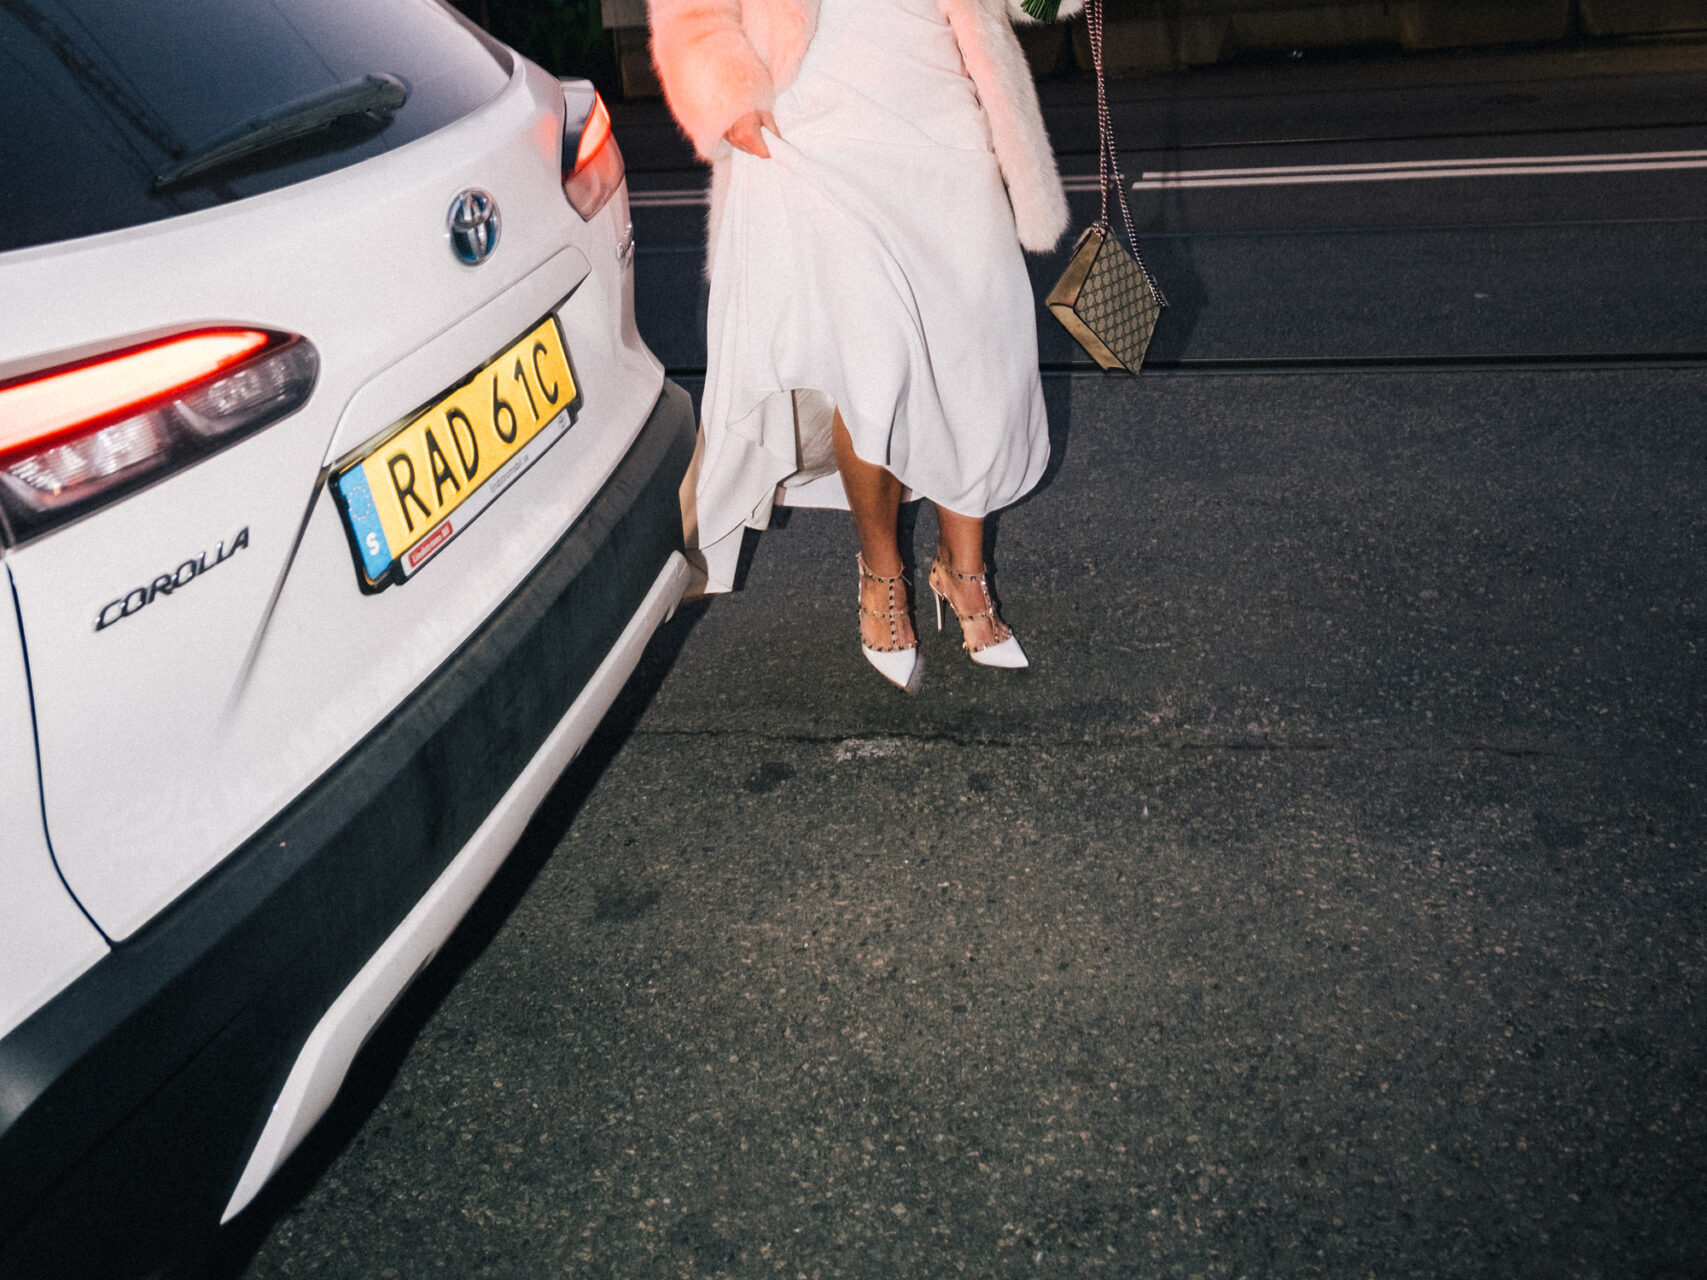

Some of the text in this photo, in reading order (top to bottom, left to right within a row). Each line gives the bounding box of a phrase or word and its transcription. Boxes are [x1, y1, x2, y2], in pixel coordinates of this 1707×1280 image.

[387, 341, 560, 533] RAD 61C
[94, 525, 250, 632] COROLLA
[365, 530, 381, 556] S
